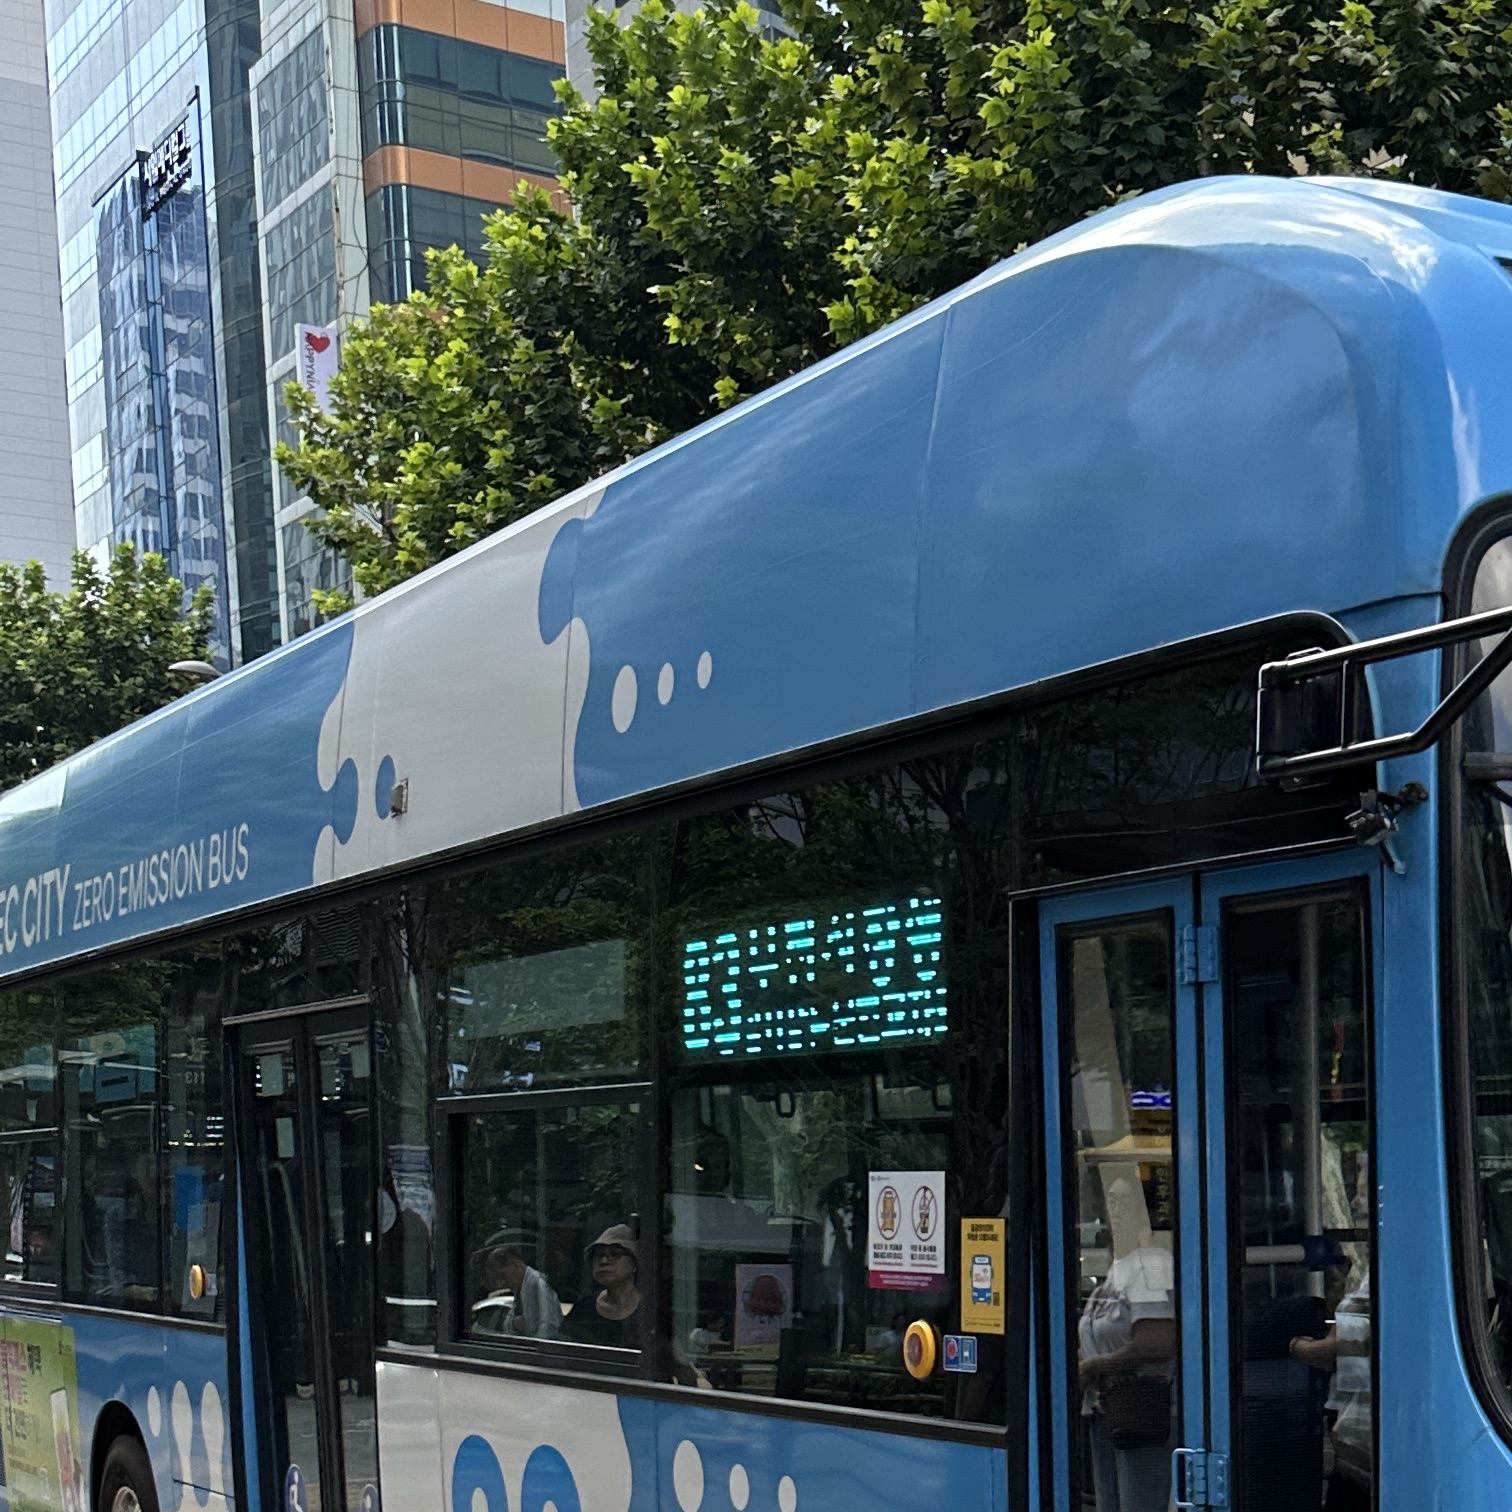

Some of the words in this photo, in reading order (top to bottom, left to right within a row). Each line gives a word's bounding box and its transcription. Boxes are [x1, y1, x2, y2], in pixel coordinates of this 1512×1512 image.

[22, 864, 71, 948] CITY
[73, 871, 115, 931] ZERO
[118, 838, 204, 917] EMISSION
[208, 822, 249, 889] BUS
